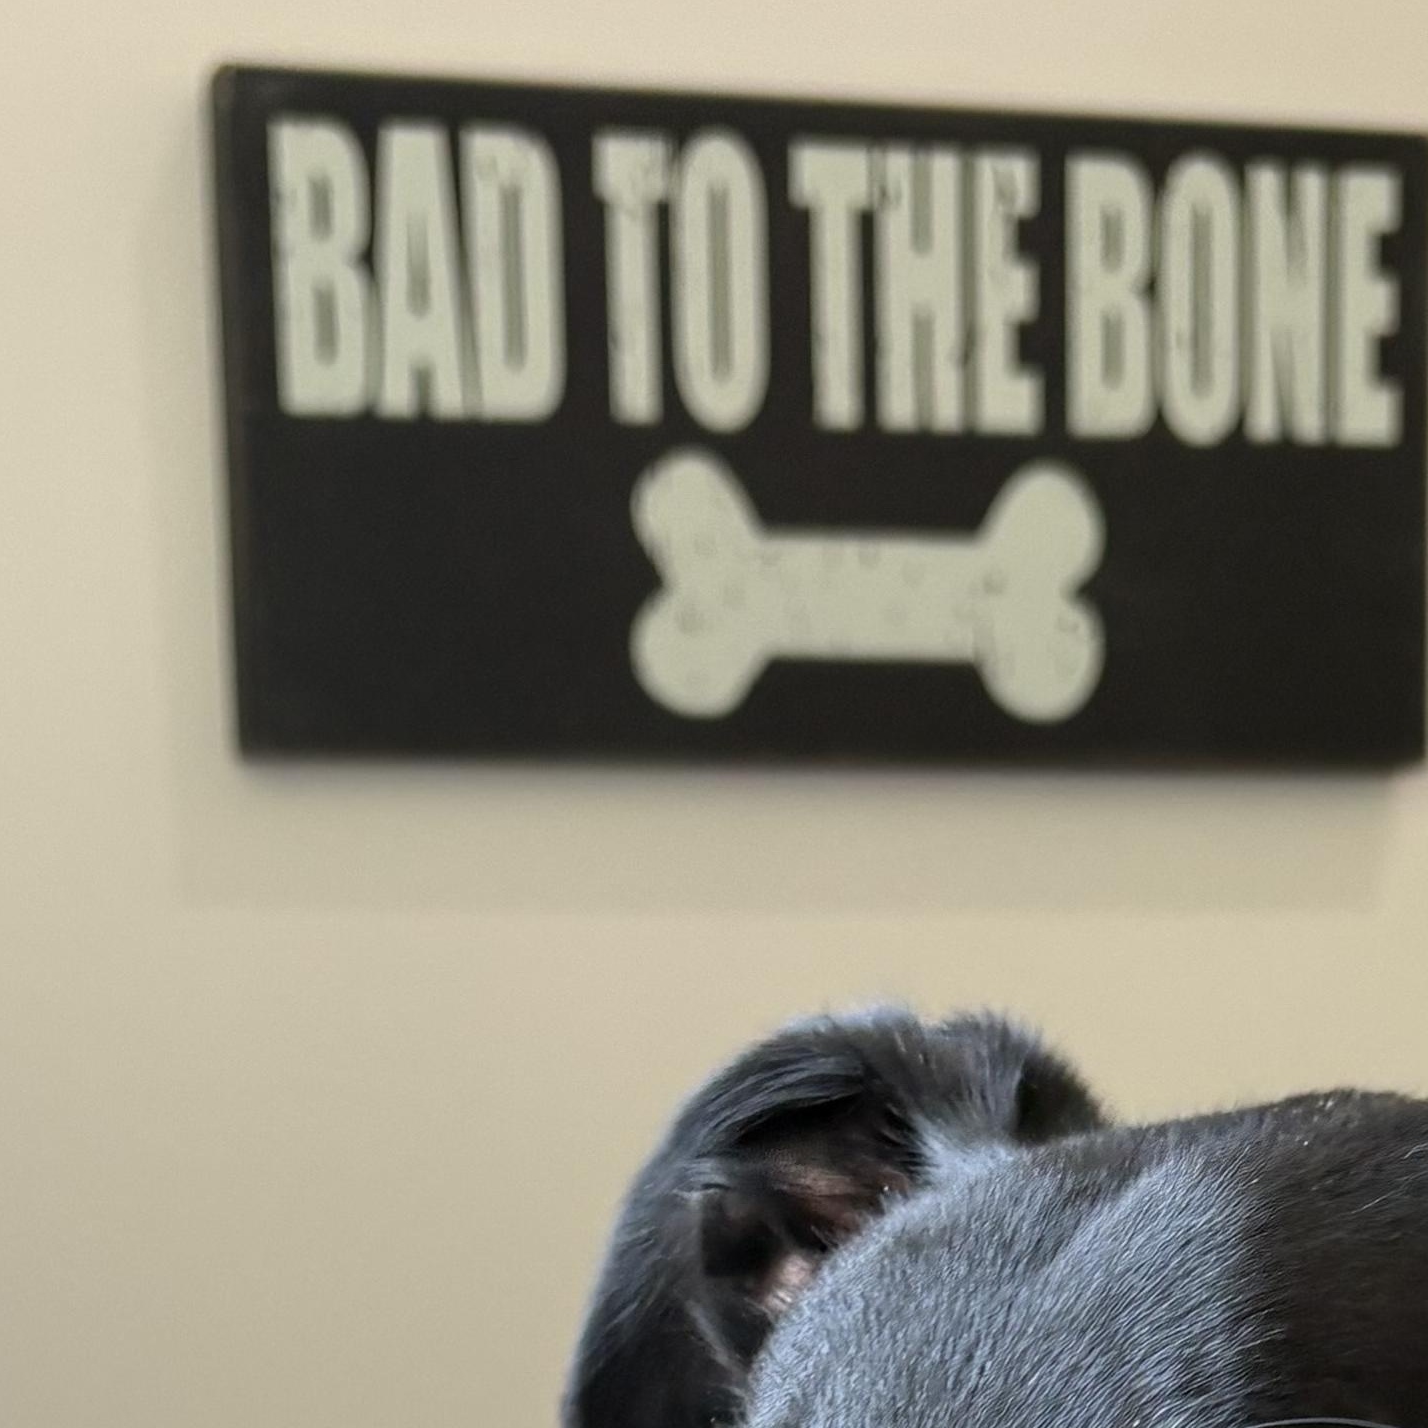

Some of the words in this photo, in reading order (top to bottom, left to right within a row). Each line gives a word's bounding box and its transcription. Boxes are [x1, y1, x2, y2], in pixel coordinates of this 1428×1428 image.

[266, 116, 567, 422] BAD
[591, 127, 770, 433] TO
[788, 137, 1046, 434] THE
[1063, 149, 1403, 447] BONE
